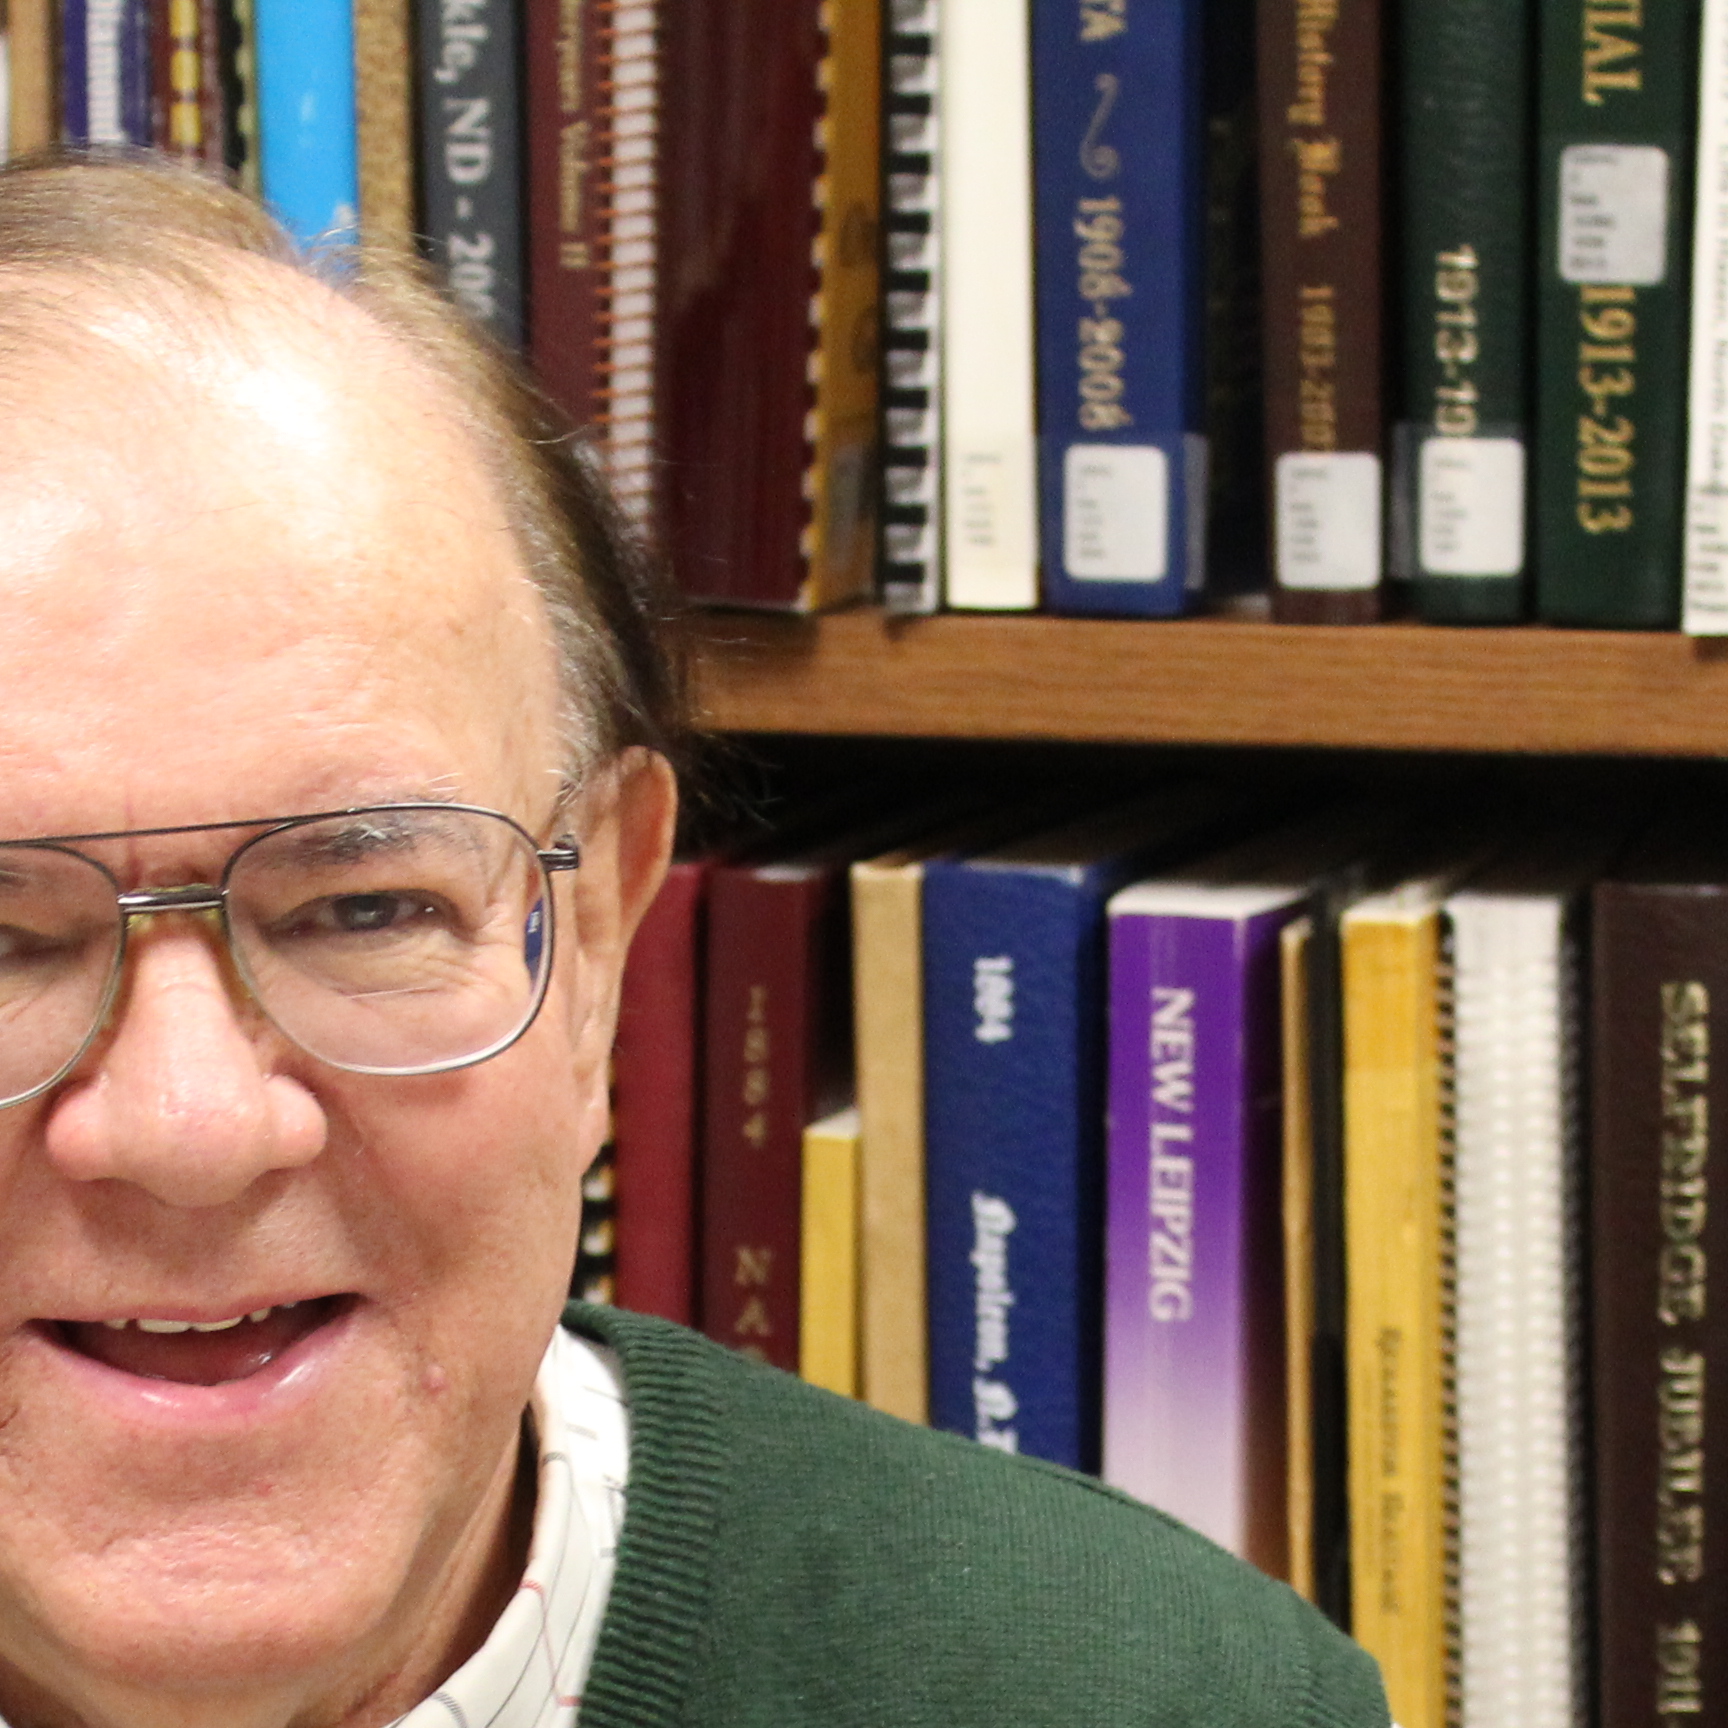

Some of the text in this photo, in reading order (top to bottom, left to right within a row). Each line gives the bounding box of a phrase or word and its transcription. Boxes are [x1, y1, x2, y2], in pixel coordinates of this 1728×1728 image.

[442, 97, 494, 184] ND
[1434, 245, 1479, 436] 1913-19
[1574, 283, 1637, 535] 1913-2013
[1147, 987, 1194, 1323] NEW LEIPZIG
